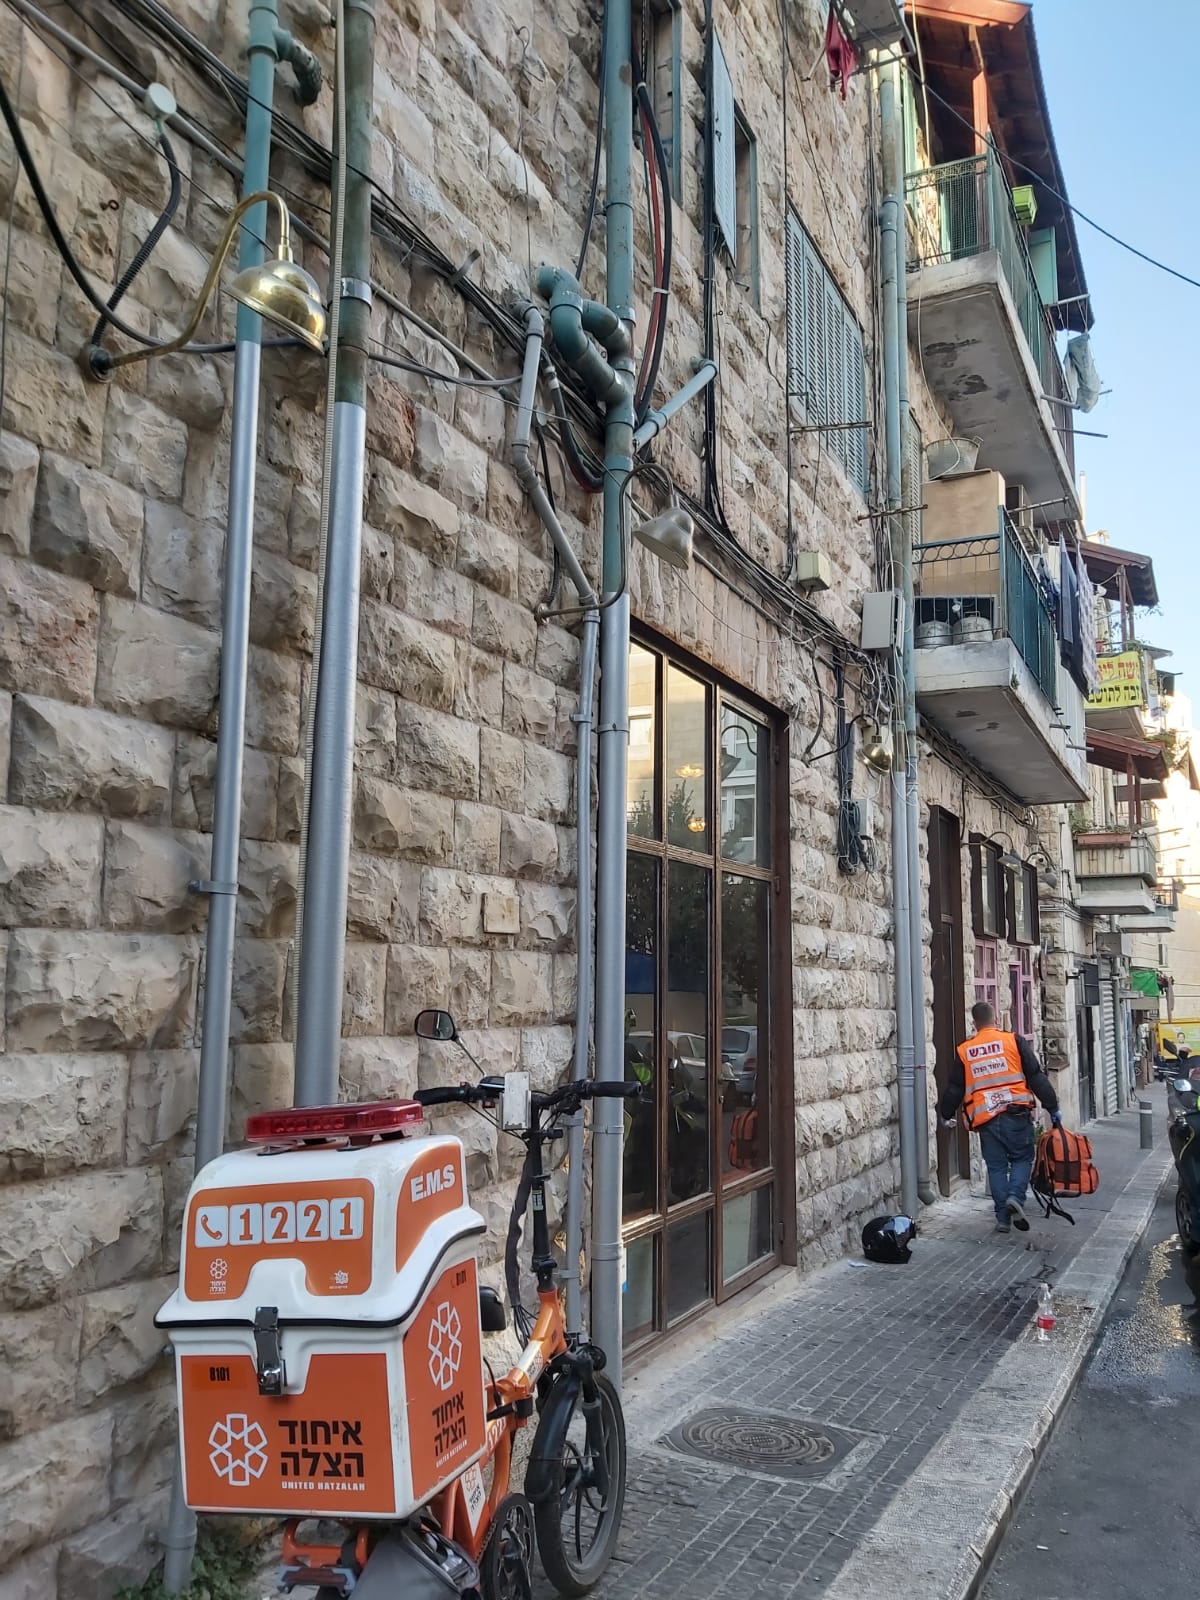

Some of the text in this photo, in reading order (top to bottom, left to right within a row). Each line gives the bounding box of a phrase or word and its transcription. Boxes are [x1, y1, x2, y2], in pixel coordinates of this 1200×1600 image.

[969, 1043, 1000, 1058] חובש
[410, 1163, 456, 1202] E.M.S
[239, 1202, 354, 1241] 1221
[432, 1391, 464, 1428] איחוד
[278, 1420, 363, 1446] איחוד
[434, 1416, 467, 1457] הצלה
[280, 1447, 364, 1477] הצלה
[281, 1481, 366, 1491] UNITED HATZALAH
